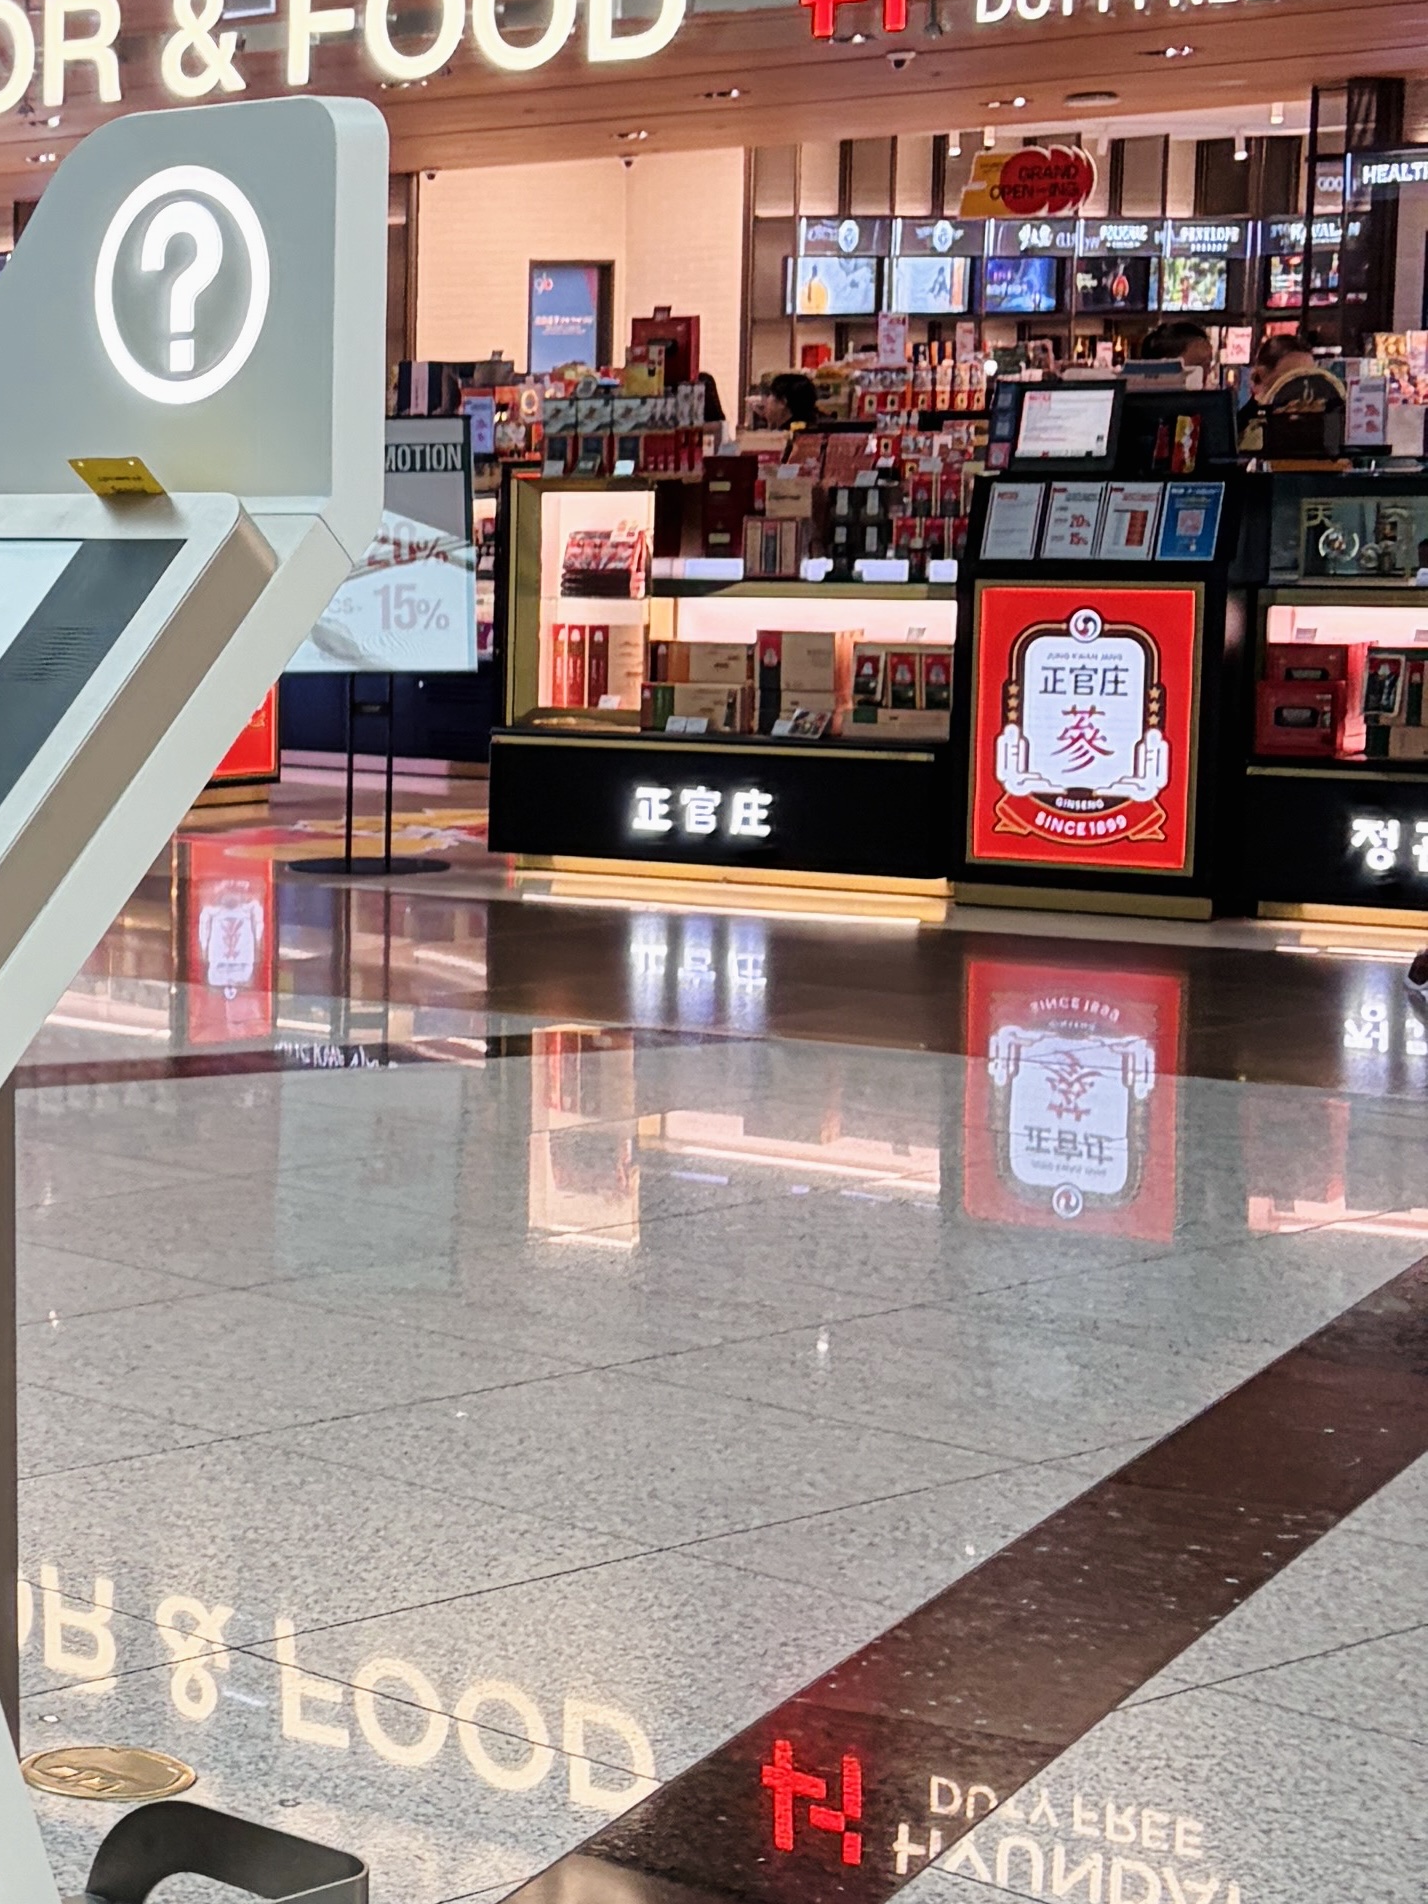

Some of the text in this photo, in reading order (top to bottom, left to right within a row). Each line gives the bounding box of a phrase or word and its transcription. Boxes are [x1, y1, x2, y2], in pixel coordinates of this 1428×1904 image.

[1017, 163, 1080, 182] GRAND
[374, 584, 451, 630] 15%
[1039, 663, 1129, 698] 正官庄
[632, 784, 774, 838] 正官庄
[1055, 796, 1105, 810] GINSENG
[1034, 810, 1129, 836] SINCE 1899
